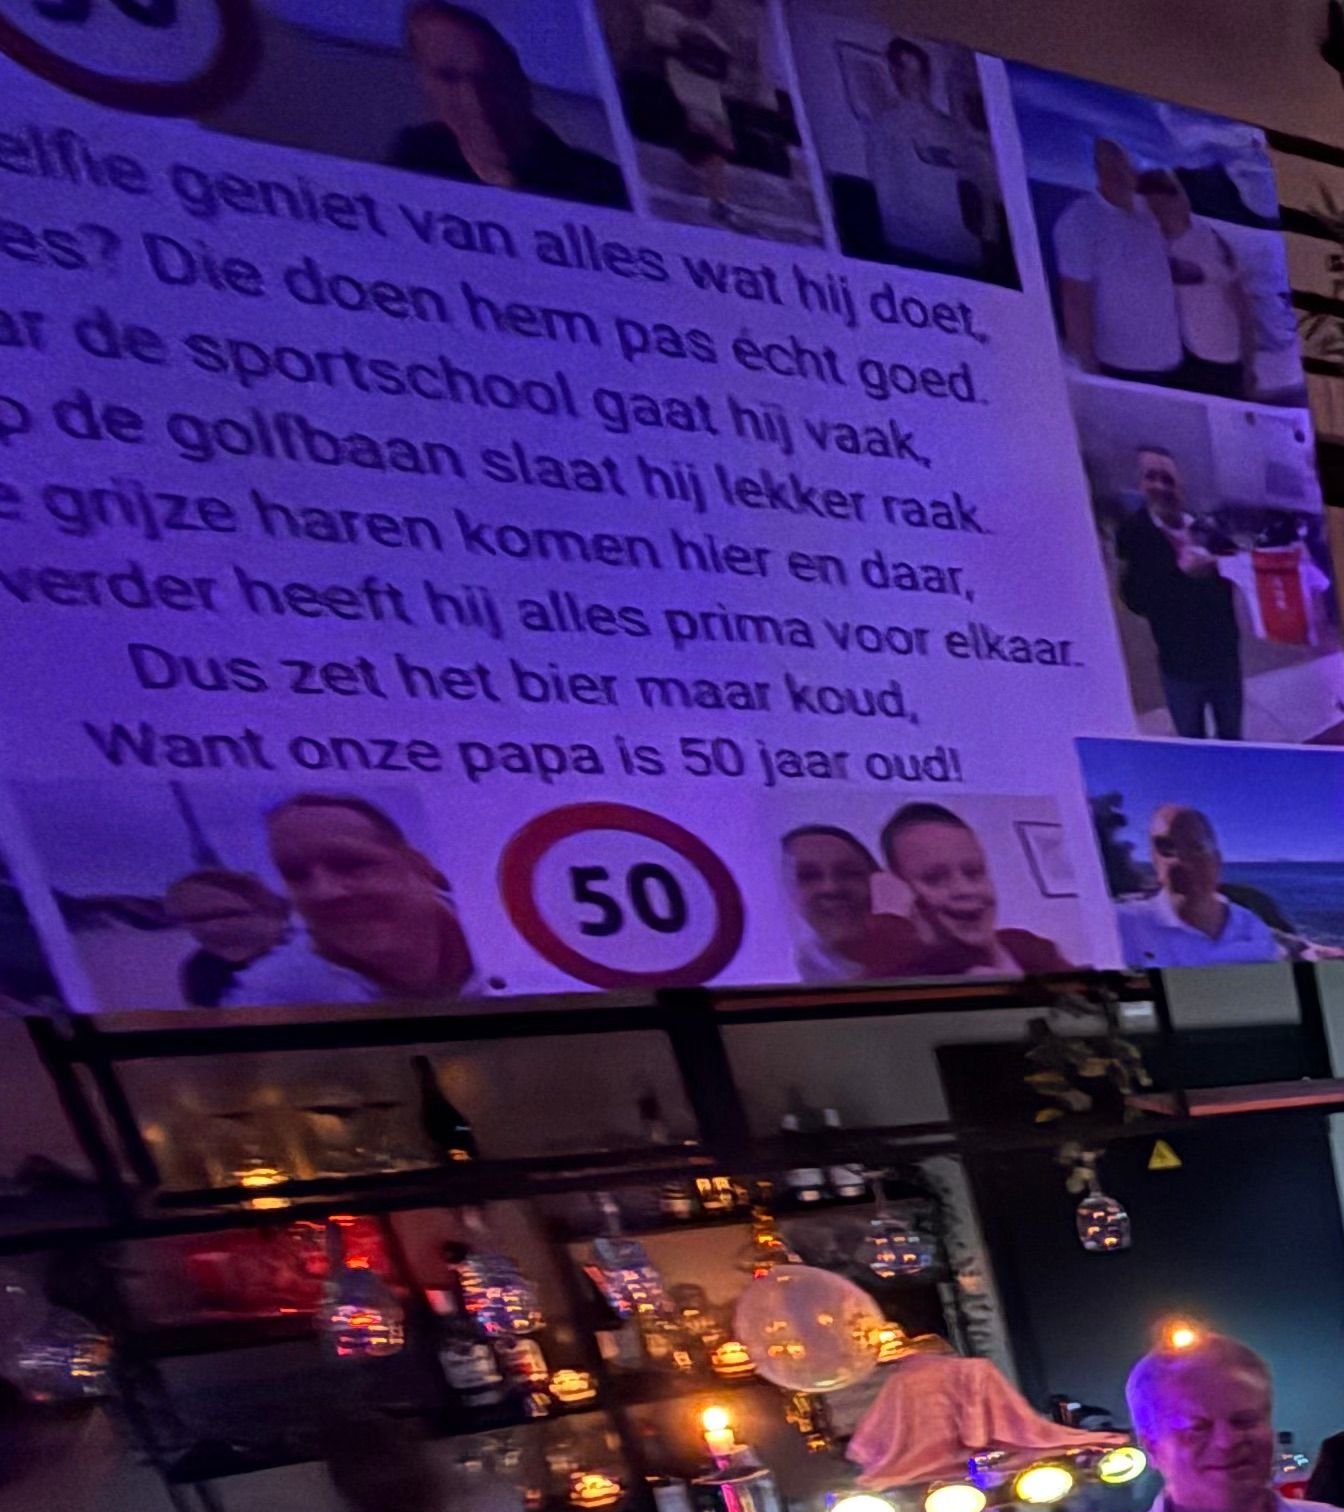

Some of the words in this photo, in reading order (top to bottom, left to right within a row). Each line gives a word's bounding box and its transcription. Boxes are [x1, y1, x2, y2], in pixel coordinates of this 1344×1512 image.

[142, 233, 268, 297] Die
[284, 257, 450, 325] doen
[462, 282, 602, 347] hem
[615, 314, 719, 364] pas
[170, 163, 386, 236] geniet
[400, 203, 517, 260] van
[535, 222, 669, 284] alles
[682, 246, 782, 305] wat
[795, 263, 858, 330] hij
[870, 280, 990, 344] doet,
[74, 306, 168, 366] de
[183, 330, 578, 418] sportschool
[592, 375, 718, 435] gaat
[728, 395, 794, 457] hij
[803, 417, 932, 470] vaak,
[53, 390, 145, 444] de
[166, 410, 466, 480] golfbaan
[482, 440, 627, 495] slaat
[637, 455, 703, 515] hij
[716, 462, 866, 523] lekker
[42, 476, 238, 541] grijze
[253, 490, 443, 552] haren
[455, 510, 662, 568] komen
[672, 525, 772, 577] hier
[788, 548, 846, 586] en
[860, 548, 974, 602] daar,
[0, 560, 218, 614] verder
[232, 565, 412, 625] heeft
[422, 580, 502, 638] hij
[518, 590, 650, 638] alles
[664, 603, 816, 650] prima
[823, 616, 930, 656] voor
[946, 620, 1085, 668] elkaar.
[127, 642, 269, 695] Dus
[280, 655, 386, 697] zet
[398, 652, 502, 702] het
[508, 658, 620, 708] bier
[638, 677, 770, 712] maar
[786, 672, 920, 723] koud,
[84, 722, 275, 770] Want
[290, 735, 442, 772] onze
[460, 742, 602, 782] papa
[617, 736, 665, 776] is
[680, 737, 745, 777] 50
[760, 740, 848, 787] jaar
[865, 745, 963, 782] oud!
[569, 862, 689, 936] 50
